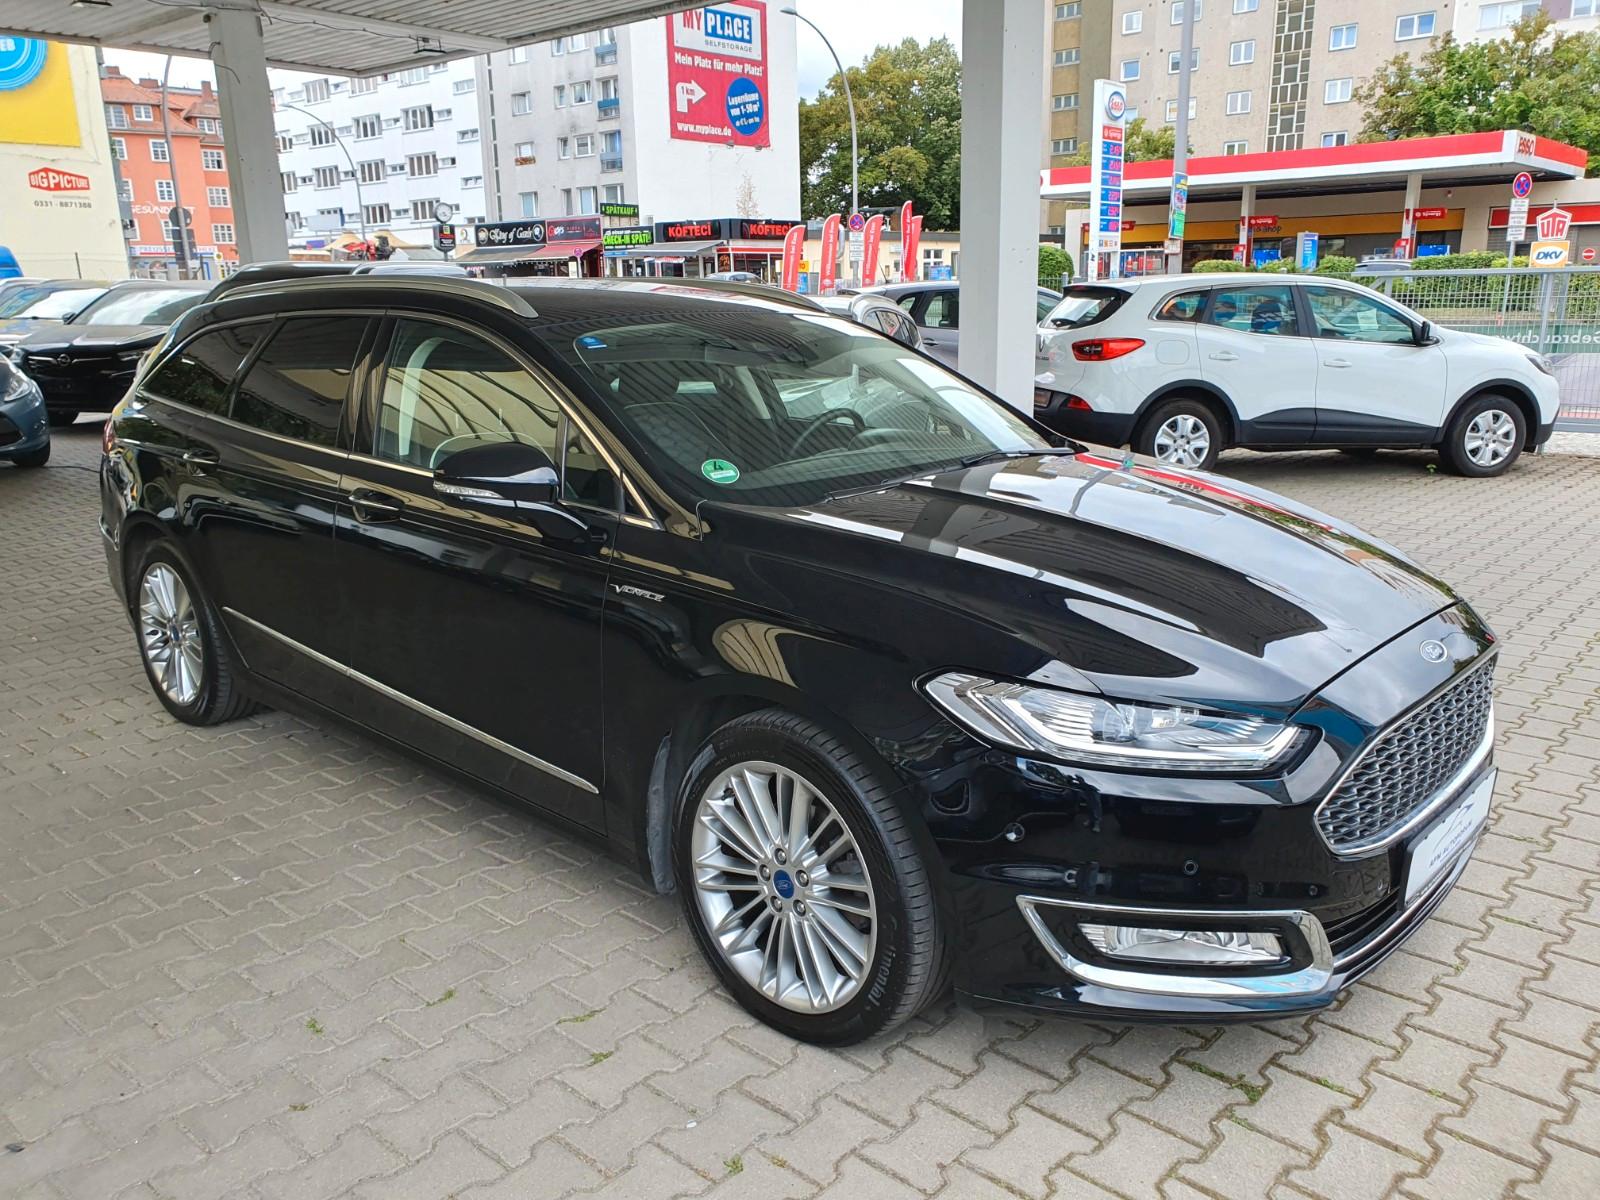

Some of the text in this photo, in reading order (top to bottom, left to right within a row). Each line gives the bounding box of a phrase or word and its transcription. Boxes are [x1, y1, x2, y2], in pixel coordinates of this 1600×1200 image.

[683, 11, 751, 41] MY PLACE
[705, 39, 752, 53] SELFSTORAGE
[675, 52, 764, 77] Mein Platz für mehr Platz!
[677, 122, 732, 137] www.myplace.de
[1518, 137, 1535, 156] ESSO
[1540, 213, 1568, 238] UTA
[1536, 251, 1563, 260] DKV
